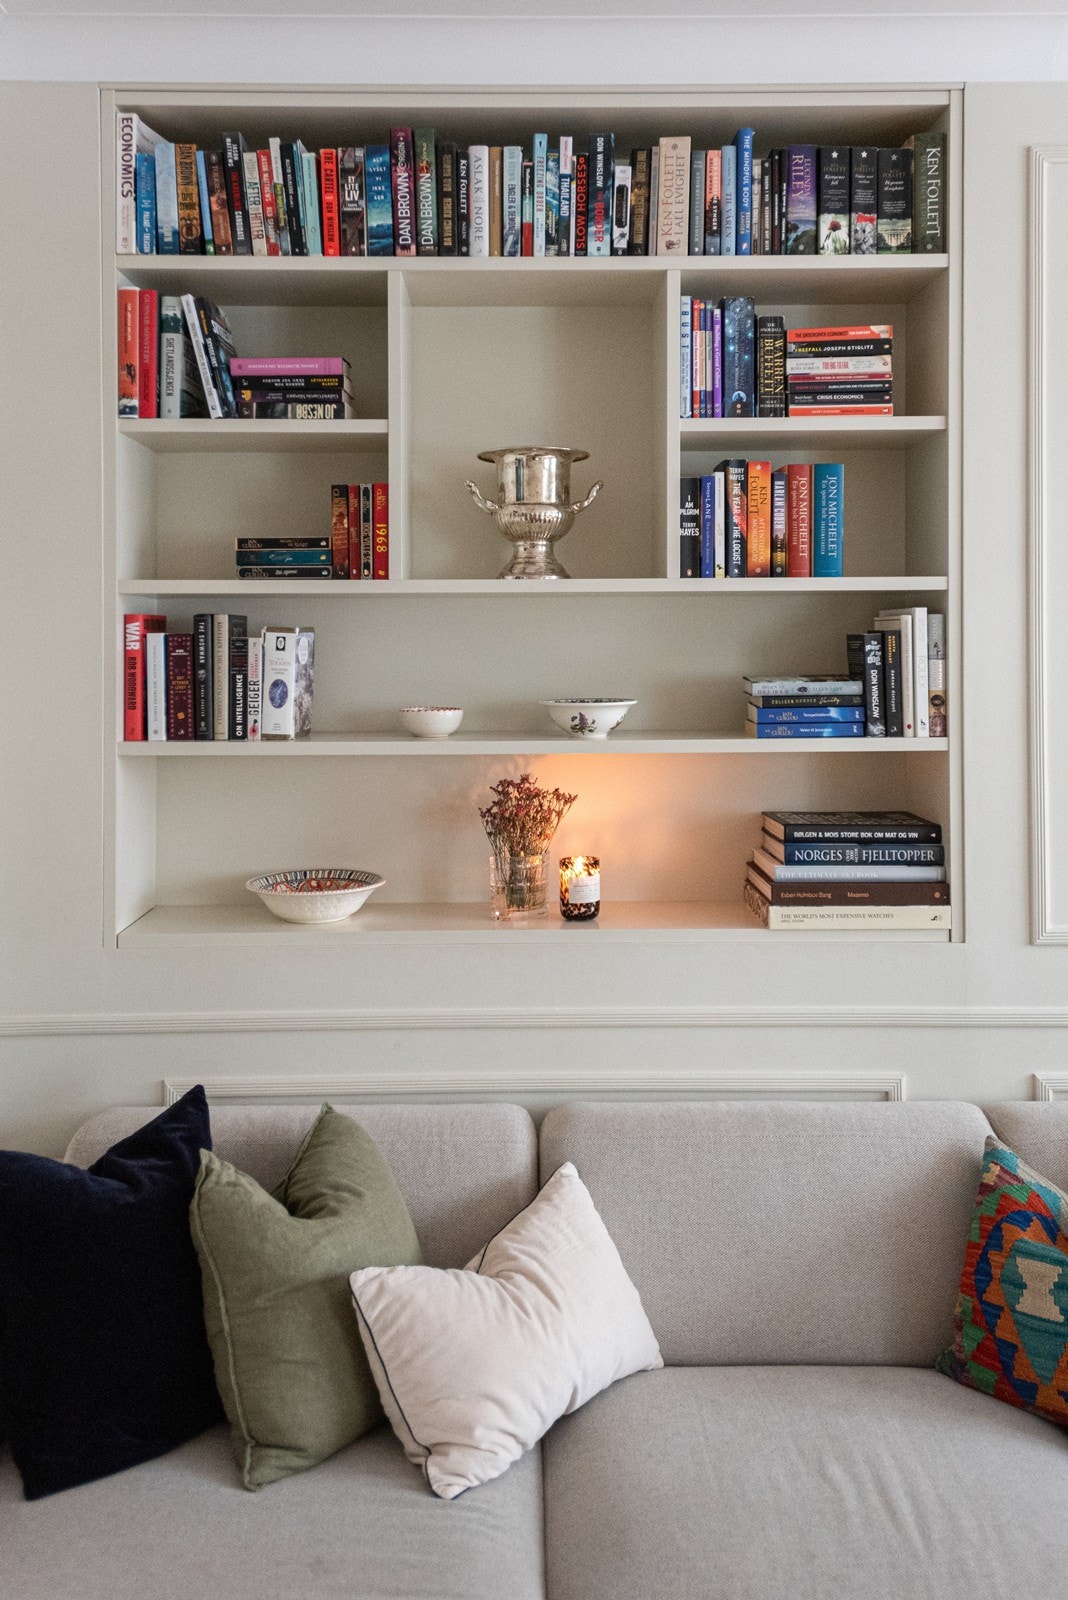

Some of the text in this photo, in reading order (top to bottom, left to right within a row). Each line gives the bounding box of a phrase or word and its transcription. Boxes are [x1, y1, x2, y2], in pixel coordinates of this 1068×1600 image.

[121, 117, 134, 199] ECONOMICS
[179, 146, 194, 186] DAN BROWN
[225, 138, 235, 167] MATTHEWS
[231, 143, 240, 161] JASON
[596, 137, 605, 187] DON WINSLOW
[742, 135, 751, 208] THE MINDFUL BODY
[323, 152, 336, 194] THE CARTEL
[344, 183, 360, 191] LITE
[348, 176, 355, 184] ET
[460, 159, 469, 215] KEN FOLLETT
[536, 156, 545, 213] FREEZING ORDER
[674, 155, 685, 204] EVIGHET
[792, 154, 805, 200] RILEY
[804, 158, 812, 197] LUCINDA
[925, 147, 942, 237] KEN FOLLETT
[247, 181, 265, 240] AFTER HITLER
[344, 190, 360, 201] LIV
[396, 172, 411, 216] BROWN
[419, 173, 434, 245] DAN BROWN
[473, 154, 485, 242] ASLAK NORE
[507, 184, 517, 203] ENGLER
[560, 178, 571, 217] THAILAND
[576, 164, 587, 250] SLOW HORSES
[661, 153, 674, 236] KEN FOLLETT
[725, 191, 733, 206] TIL
[235, 210, 245, 240] CANDIDATE
[325, 202, 335, 242] DON WINSLOW
[398, 220, 412, 244] DAN
[507, 211, 517, 237] DEMONER
[594, 202, 607, 242] BORDER
[674, 210, 684, 229] ALL
[725, 207, 735, 238] VÅREN
[682, 310, 690, 350] BUST
[164, 337, 175, 397] SHETLANDSGJENGEN
[764, 338, 774, 393] BUFFETT
[774, 339, 784, 393] WARREN
[822, 361, 830, 370] TOO
[325, 403, 337, 419] JO
[749, 475, 760, 516] FOLLETT
[760, 486, 768, 505] KEN
[774, 480, 785, 506] HARLAN
[792, 480, 798, 489] En
[821, 480, 828, 489] En
[680, 528, 700, 537] HAYES
[732, 482, 741, 565] THE YEAR OF THE LOCUST
[774, 508, 785, 529] COBEN
[796, 475, 808, 558] JON MICHELET
[826, 475, 838, 558] JON MICHELET
[376, 523, 388, 552] 1968
[125, 621, 141, 711] WAR BOB WOODWARD
[870, 669, 878, 685] DON
[917, 655, 927, 690] ROLEX
[235, 674, 243, 737] ON INTELLIGENCE
[248, 680, 260, 716] GEIGER
[872, 685, 880, 719] WINSLOW
[794, 849, 842, 861] NORGES
[862, 849, 934, 864] FJELLTOPPER
